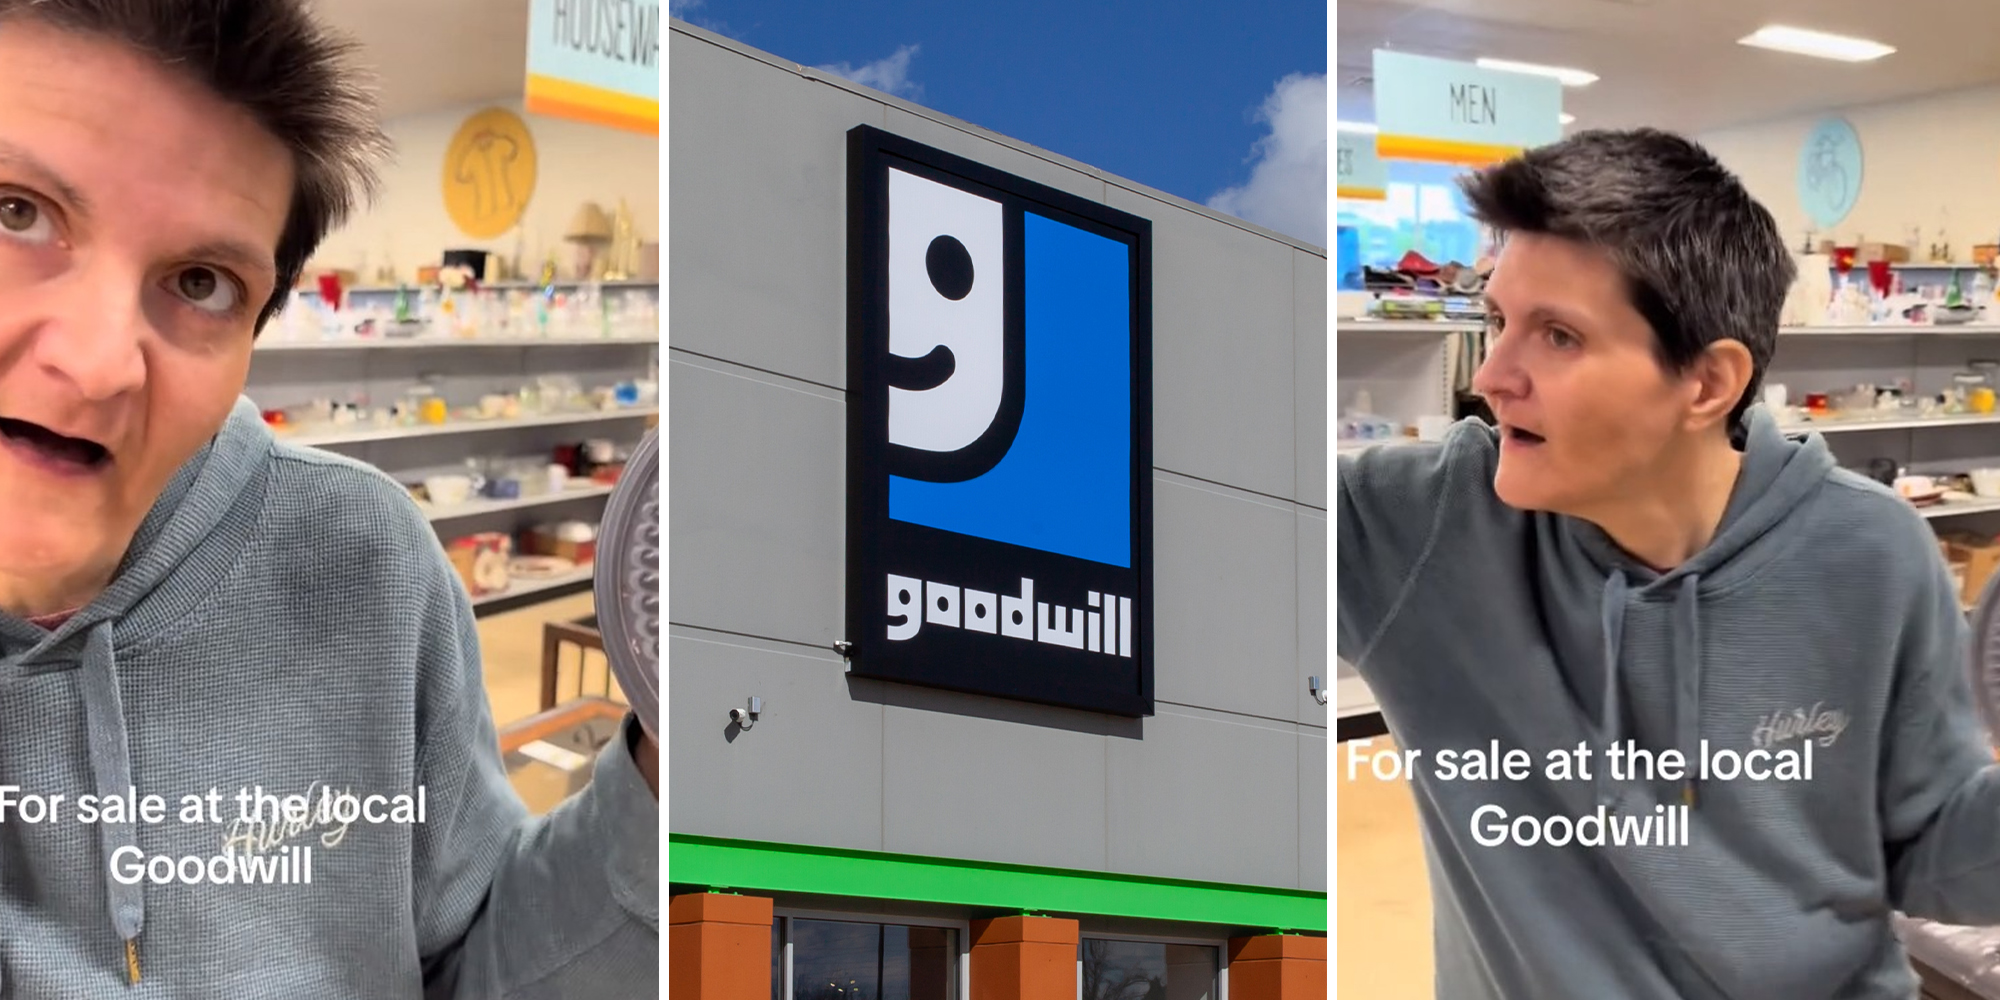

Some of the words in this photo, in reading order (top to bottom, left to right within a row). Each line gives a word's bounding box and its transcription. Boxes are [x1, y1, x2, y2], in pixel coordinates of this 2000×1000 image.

[1449, 83, 1496, 126] MEN
[887, 573, 1132, 658] goodwill
[1752, 700, 1849, 748] Hurley
